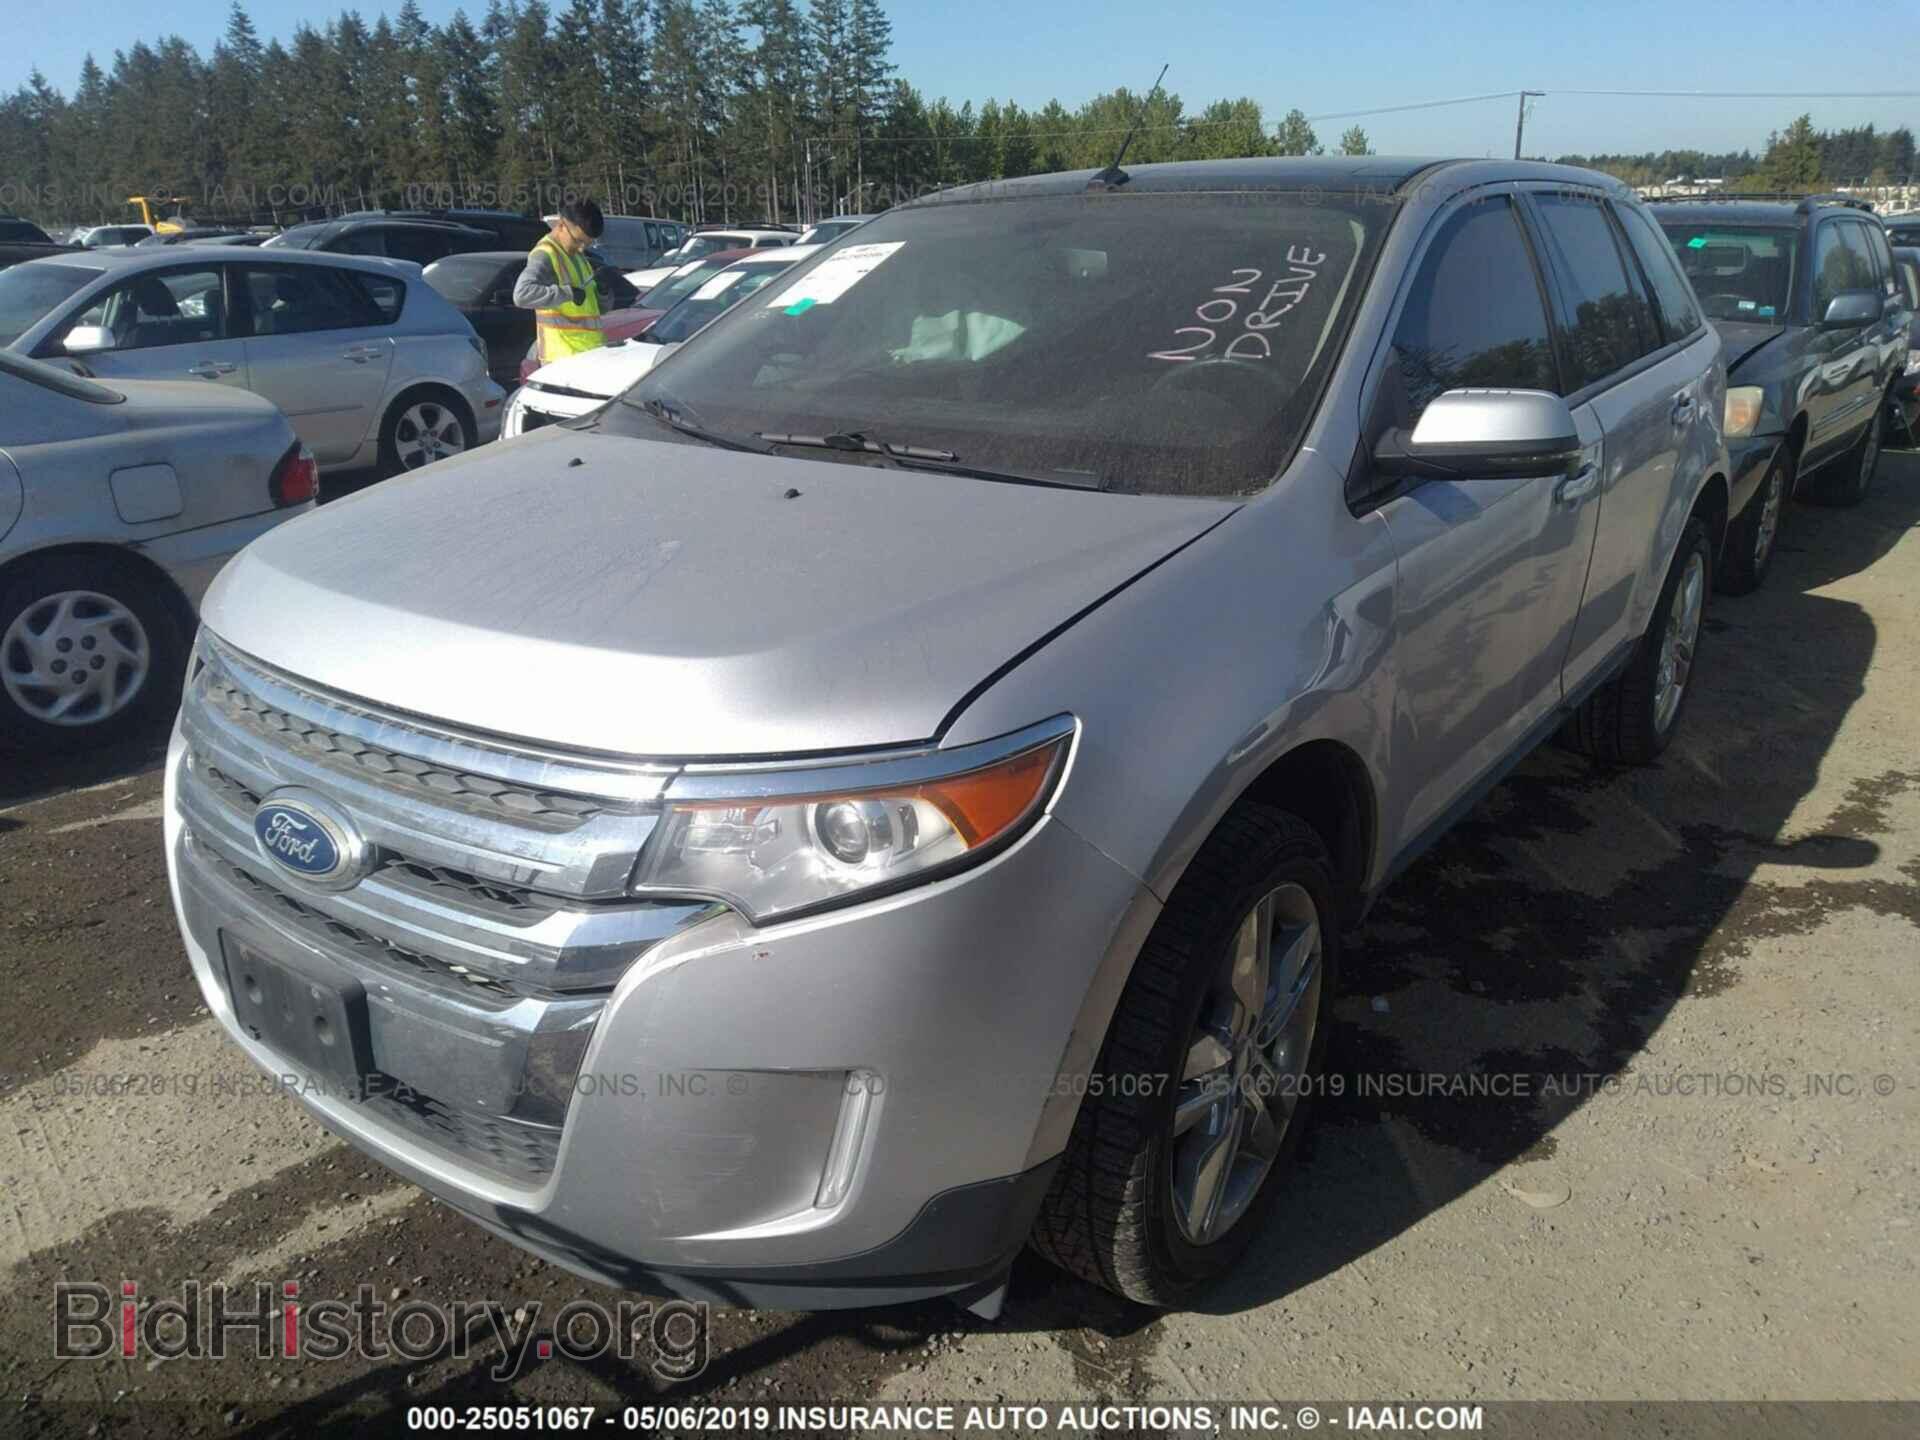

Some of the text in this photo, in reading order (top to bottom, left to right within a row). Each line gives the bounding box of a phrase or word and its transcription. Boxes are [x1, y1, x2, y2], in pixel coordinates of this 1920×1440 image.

[1147, 268, 1262, 360] NON
[1224, 244, 1327, 360] DRIVE
[264, 812, 319, 864] Ford
